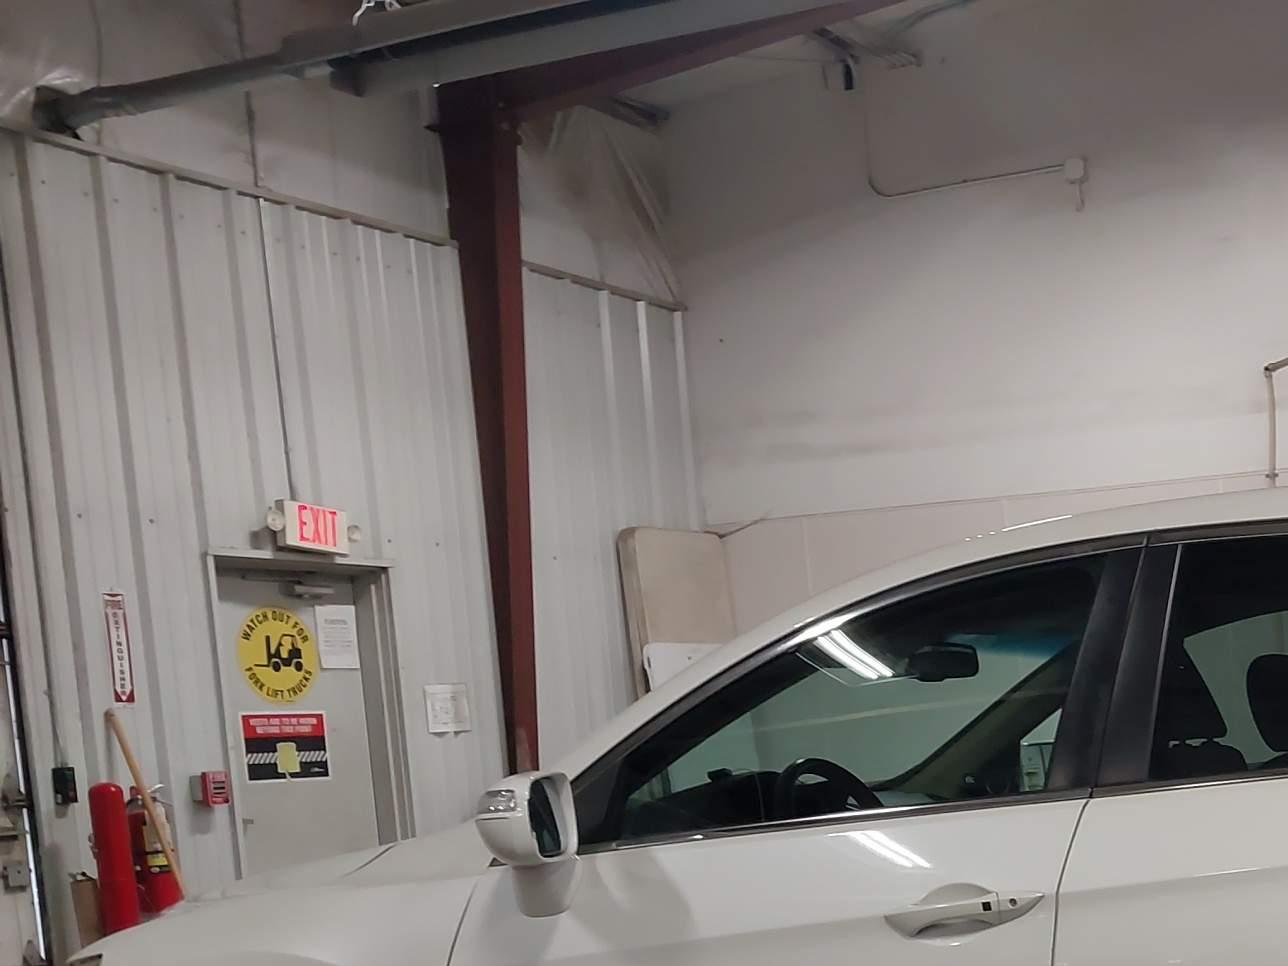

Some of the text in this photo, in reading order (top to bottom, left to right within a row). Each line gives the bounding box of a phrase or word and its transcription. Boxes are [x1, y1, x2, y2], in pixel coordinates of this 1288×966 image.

[298, 504, 337, 548] EXIT
[241, 610, 269, 641] WATCH
[271, 610, 291, 624] OUT
[292, 621, 309, 644] FOR
[245, 666, 312, 699] FORK LIFT TRUCKS
